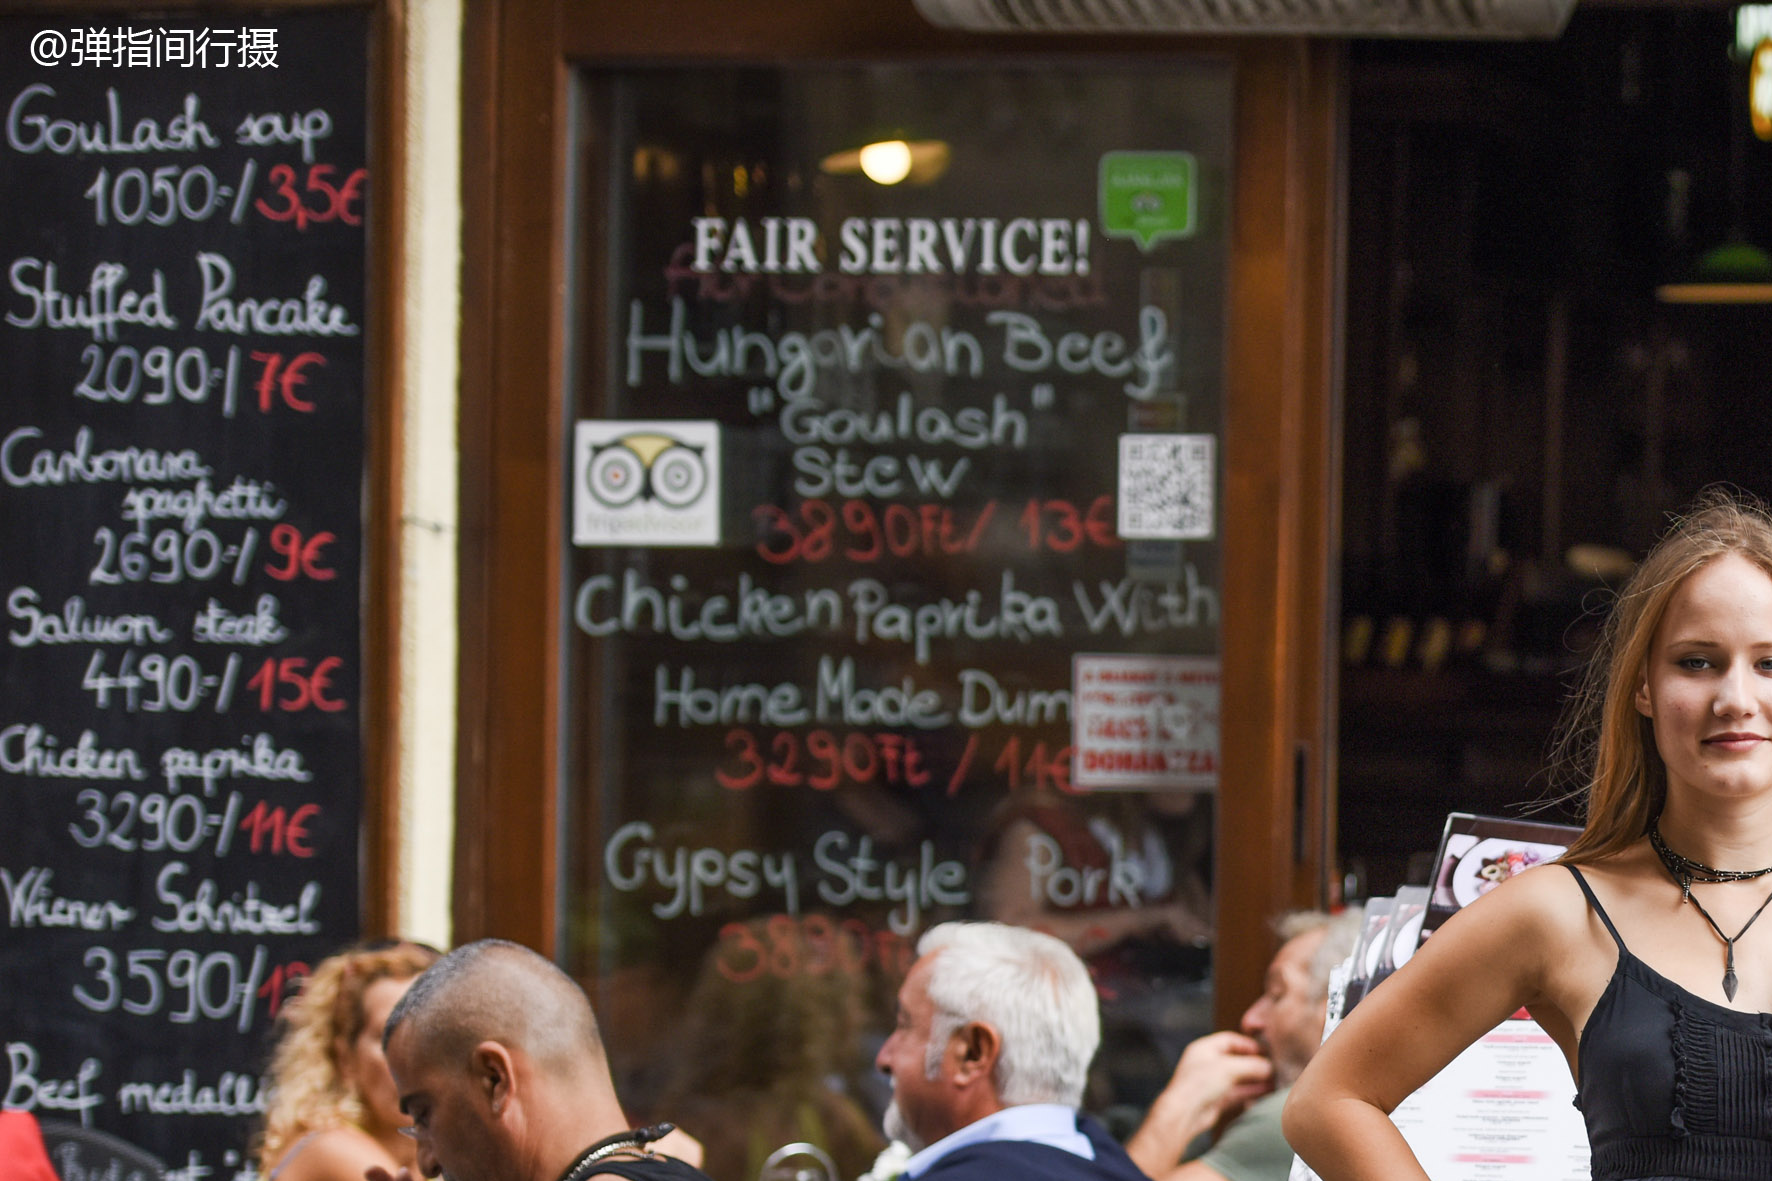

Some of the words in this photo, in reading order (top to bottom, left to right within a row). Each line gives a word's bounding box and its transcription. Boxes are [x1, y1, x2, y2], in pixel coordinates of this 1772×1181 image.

[235, 108, 332, 164] soup
[691, 217, 824, 275] FAIR
[838, 217, 1091, 276] SERVICE!
[4, 256, 178, 341] Stuffed
[195, 250, 360, 337] Pancake
[625, 296, 983, 400] Hungarian
[985, 306, 1175, 400] Beef
[249, 350, 328, 413] 7€
[0, 425, 214, 487] Carbonara
[792, 444, 973, 498] Stew
[121, 474, 288, 535] spaghetti
[264, 523, 338, 582] 9€
[7, 585, 173, 648] Salmon
[193, 592, 289, 645] steak
[574, 567, 843, 642] Chicken
[849, 569, 1064, 664] Paprika
[1072, 562, 1221, 638] With
[246, 655, 349, 713] 15€
[654, 662, 811, 728] Home
[813, 652, 952, 726] Made
[0, 723, 147, 781] Chicken
[160, 731, 314, 797] paprika
[240, 799, 322, 858] 11€
[0, 865, 135, 929] Wiener
[151, 861, 322, 935] Schnitzel
[603, 823, 798, 919] Gypsy
[813, 829, 971, 938] Style
[1, 1041, 104, 1129] Beef
